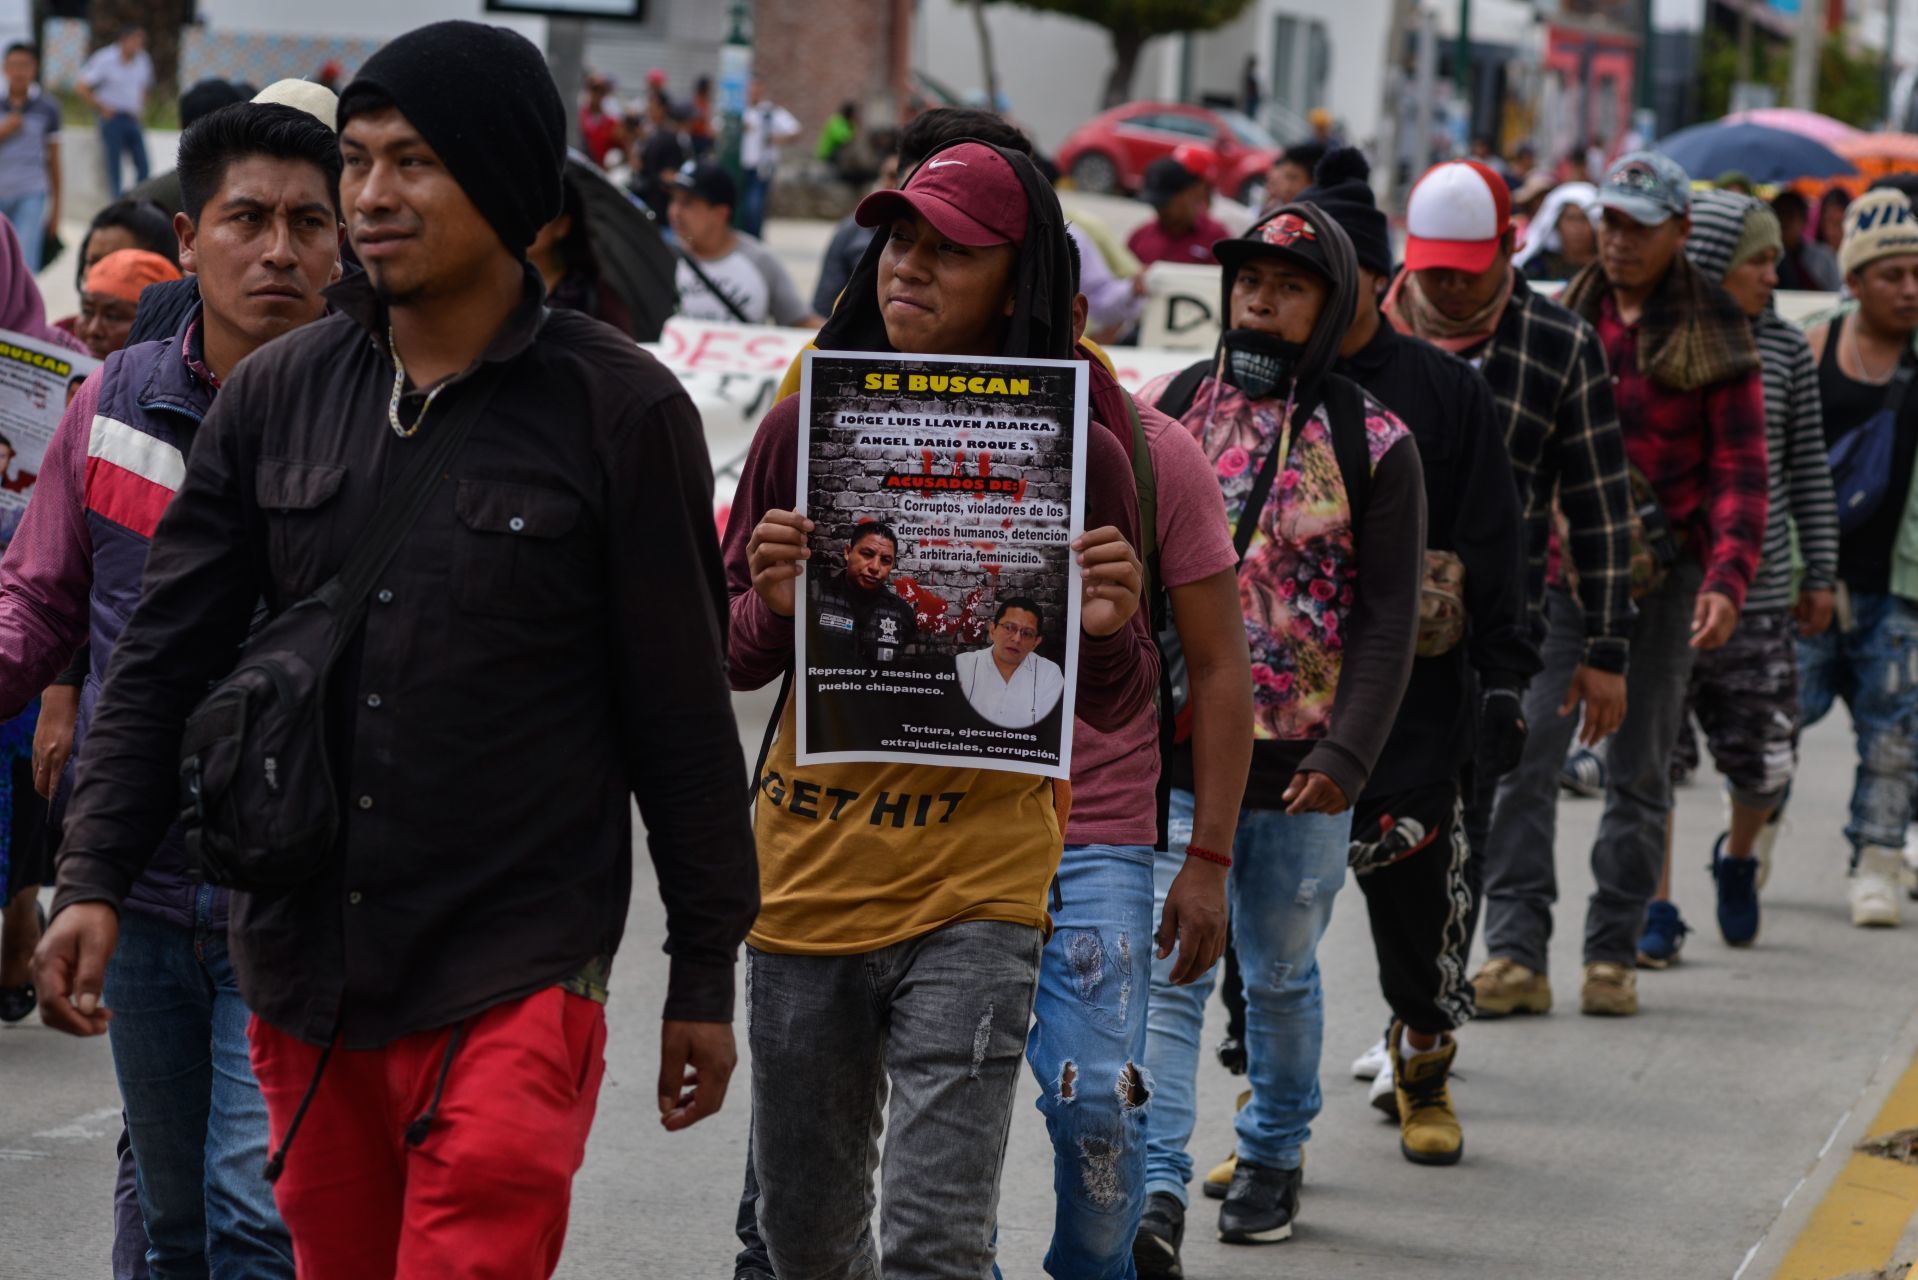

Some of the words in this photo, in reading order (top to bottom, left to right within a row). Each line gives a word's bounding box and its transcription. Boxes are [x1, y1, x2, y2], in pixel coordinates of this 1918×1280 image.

[864, 373, 900, 391] SE
[908, 374, 1030, 396] BUSCAN
[839, 415, 883, 425] JORGE
[888, 417, 921, 427] LUIS
[925, 418, 982, 429] LLAVEN
[984, 421, 1056, 432] ABARCA.
[860, 436, 910, 446] ANGEL
[914, 437, 962, 448] DARÍO
[966, 440, 1017, 450] ROQUE
[1020, 442, 1034, 451] S.
[886, 476, 985, 490] ACUSADOS
[989, 480, 1019, 492] DE:
[904, 500, 964, 515] Corruptos,
[967, 503, 1027, 516] violadores
[1029, 505, 1043, 517] de
[1046, 505, 1064, 518] los
[898, 524, 951, 537] derechos
[953, 526, 1009, 541] humanos,
[1011, 528, 1068, 541] detención
[808, 667, 867, 677] Represor
[870, 670, 878, 678] y
[881, 669, 932, 680] asesino
[935, 672, 956, 681] del
[818, 682, 862, 693] pueblo
[865, 683, 945, 696] chiapaneco.
[902, 724, 955, 737] Tortura,
[958, 728, 1038, 742] ejecuciones
[880, 738, 983, 753] extrajudiciales,
[986, 745, 1060, 760] corrupción.
[761, 771, 859, 821] GET
[869, 791, 967, 828] HIT
